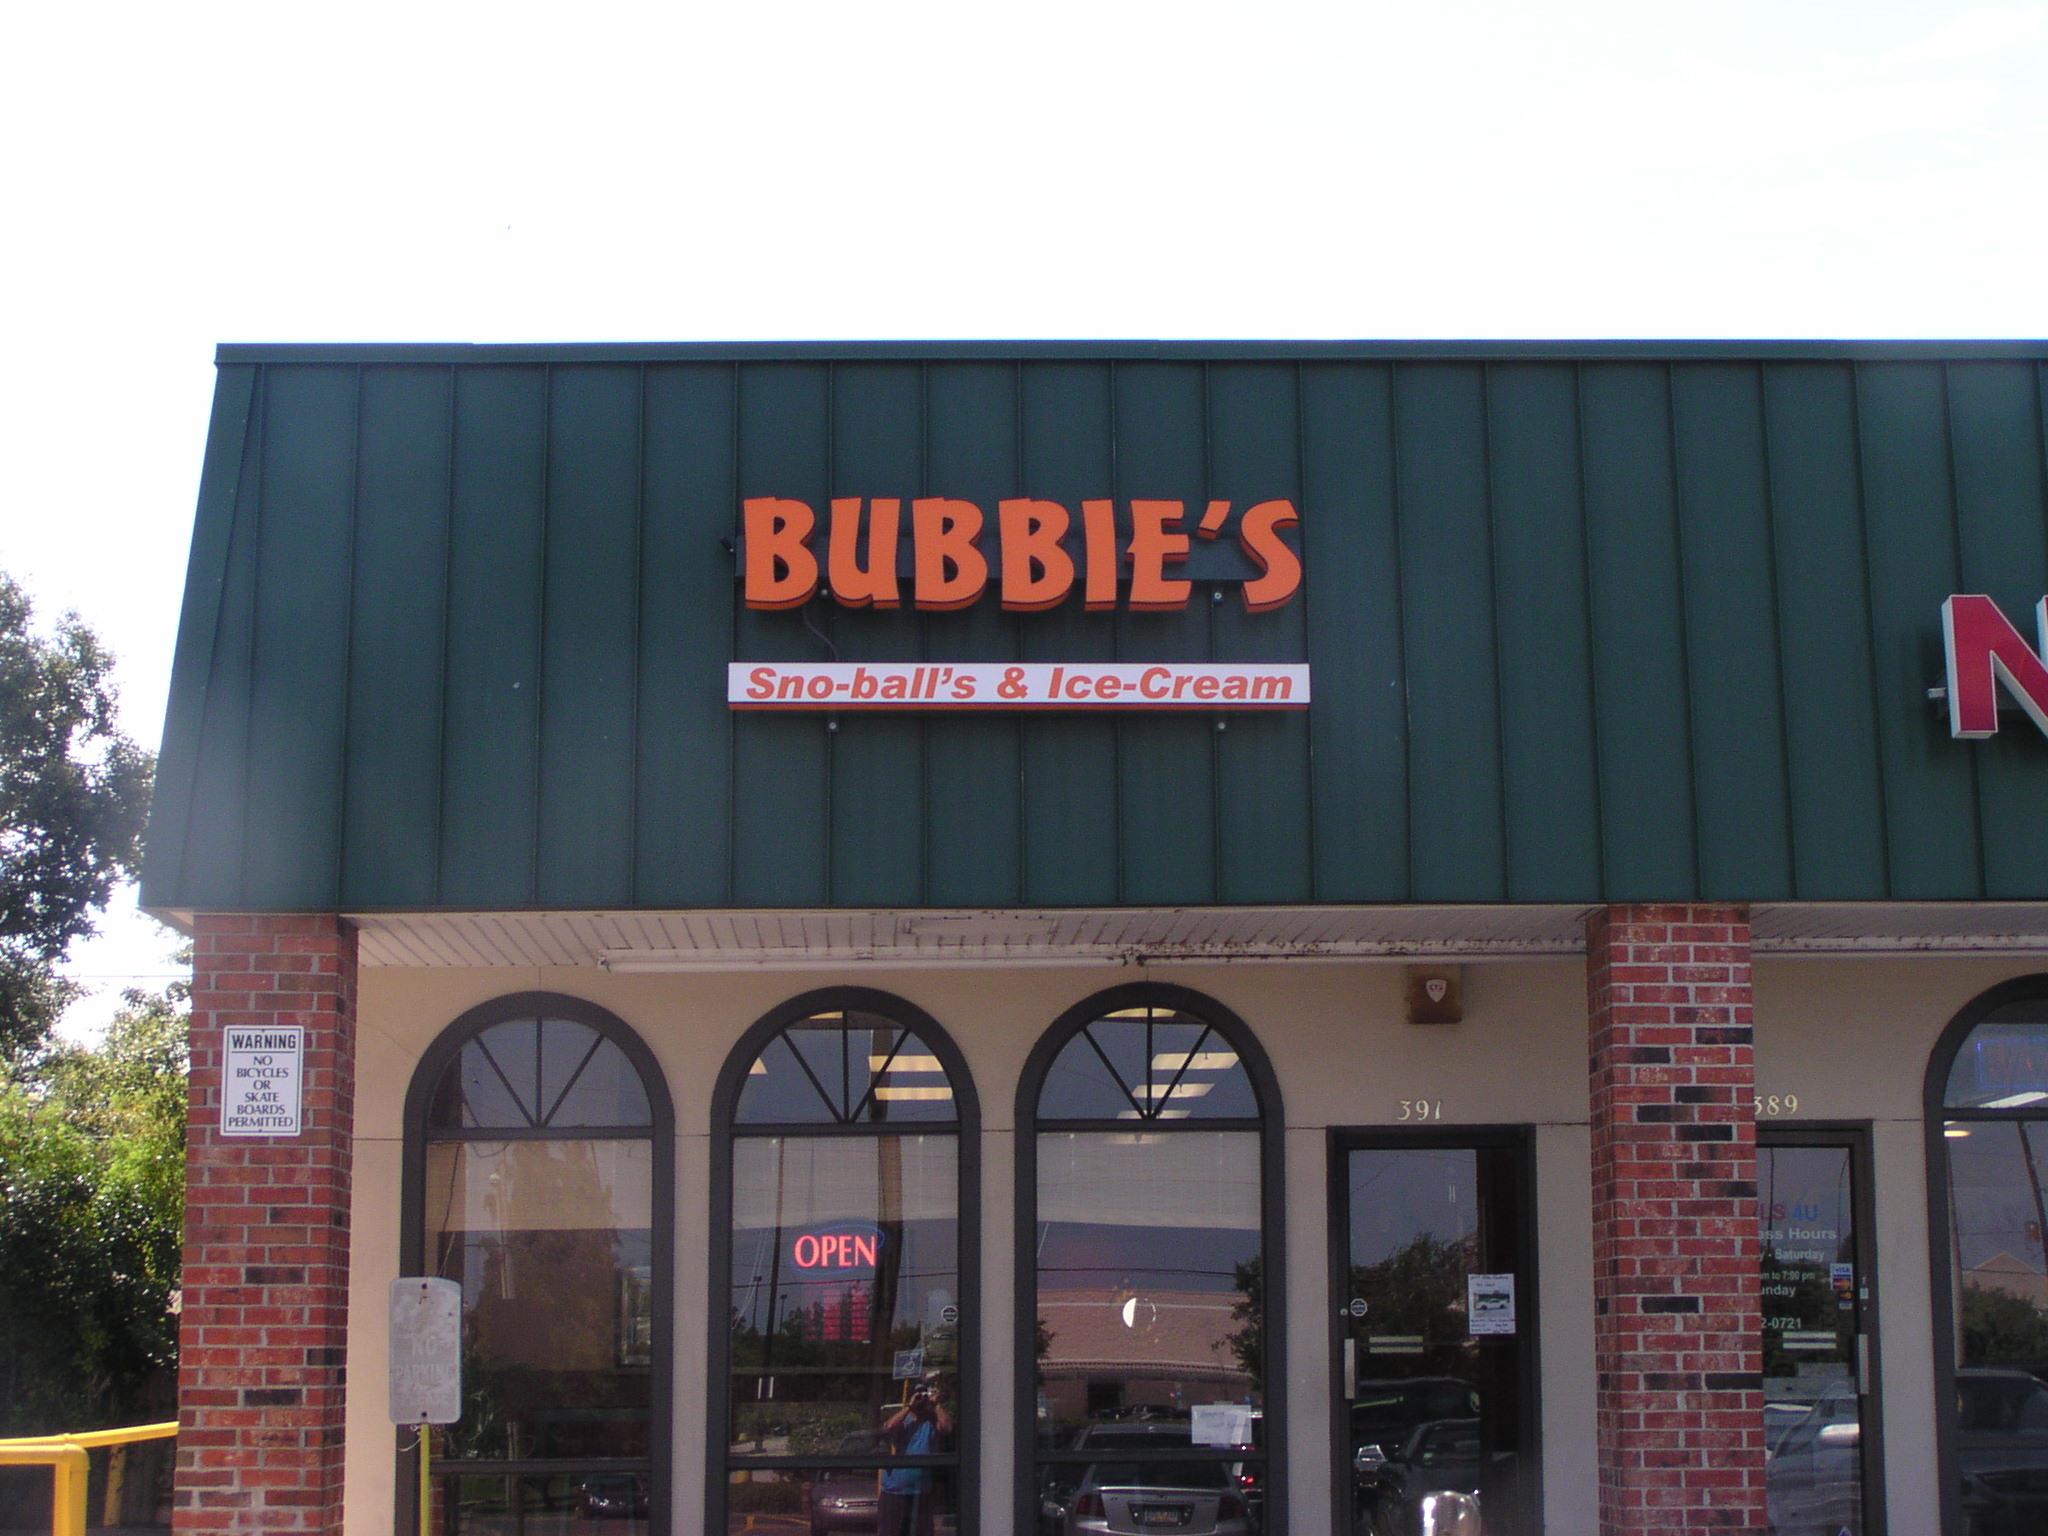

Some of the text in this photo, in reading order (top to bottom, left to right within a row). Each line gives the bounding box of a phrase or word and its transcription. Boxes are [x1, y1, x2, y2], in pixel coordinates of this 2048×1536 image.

[743, 496, 1301, 611] BUBBIE'S
[746, 666, 1293, 701] Sno-ball's & Ice-Cream
[231, 1034, 297, 1049] WARNING
[253, 1055, 273, 1066] NO
[236, 1067, 289, 1078] BICYCLES
[252, 1079, 272, 1090] OR
[244, 1091, 280, 1102] SKATE
[236, 1104, 286, 1115] BOARDS
[1397, 1100, 1441, 1120] 391
[1754, 1094, 1798, 1115] 389
[227, 1116, 294, 1127] PERMITTED
[1788, 1227, 1837, 1240] Hours
[794, 1234, 878, 1268] OPEN
[1775, 1248, 1825, 1263] Saturday
